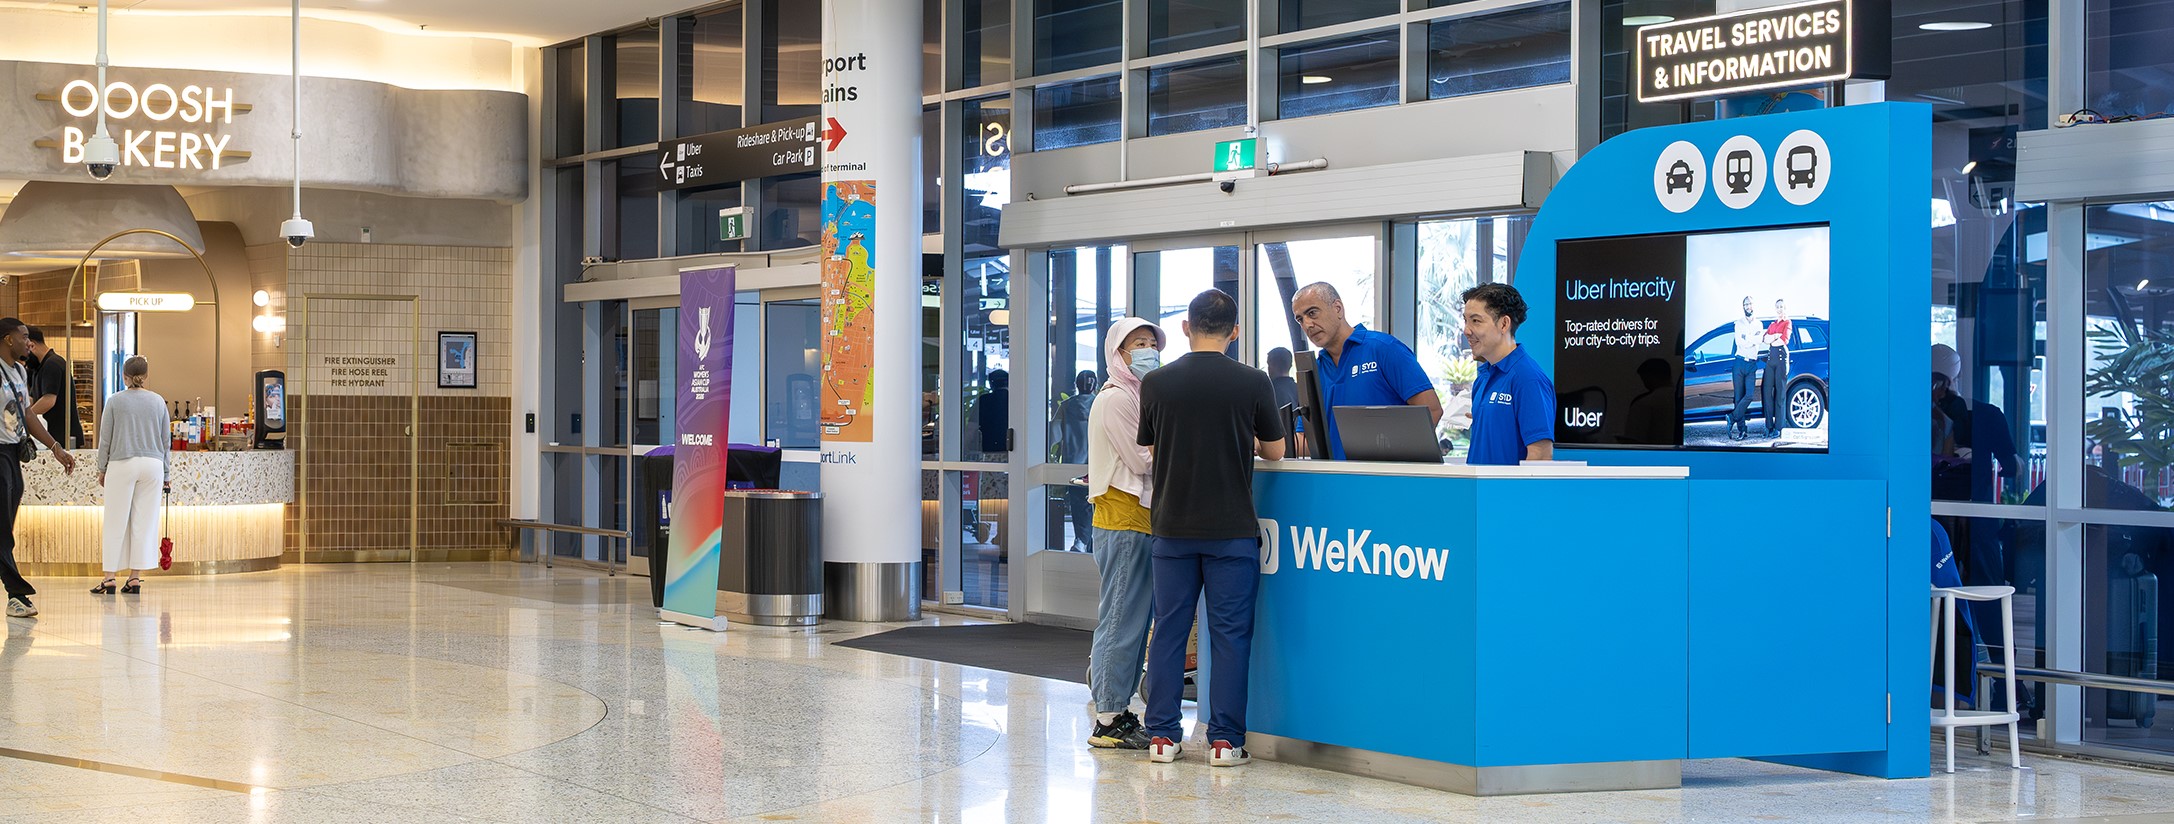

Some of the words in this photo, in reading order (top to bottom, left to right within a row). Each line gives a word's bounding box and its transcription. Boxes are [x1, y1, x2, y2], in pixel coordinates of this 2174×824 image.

[1646, 26, 1726, 58] TRAVEL
[1731, 9, 1840, 47] SERVICES
[1654, 66, 1669, 90] &
[1673, 45, 1832, 88] INFORMATION
[61, 80, 233, 124] OOOSH
[737, 132, 770, 148] Rideshare
[771, 129, 777, 143] &
[777, 126, 805, 142] Pick-up
[63, 126, 231, 170] BKERY
[686, 143, 702, 156] Uber
[772, 152, 785, 166] Car
[786, 149, 803, 164] Park
[686, 164, 703, 178] Taxis
[830, 162, 866, 172] terminal
[1566, 279, 1606, 300] Uber
[1609, 276, 1676, 302] Intercity
[129, 297, 150, 306] PICK
[151, 297, 164, 306] UP
[1565, 319, 1610, 334] Top-rated
[1611, 319, 1642, 331] drivers
[1644, 317, 1658, 330] for
[1564, 335, 1584, 349] your
[1585, 333, 1637, 348] city-to-city
[1638, 333, 1660, 347] trips.
[324, 356, 340, 364] FIRE
[342, 357, 396, 365] EXTINGUISHER
[1362, 361, 1378, 371] SYD
[331, 368, 347, 376] FIRE
[372, 368, 388, 376] REEL
[1564, 407, 1603, 427] Uber
[682, 434, 713, 446] WELCOME
[1289, 525, 1450, 581] WeKnow
